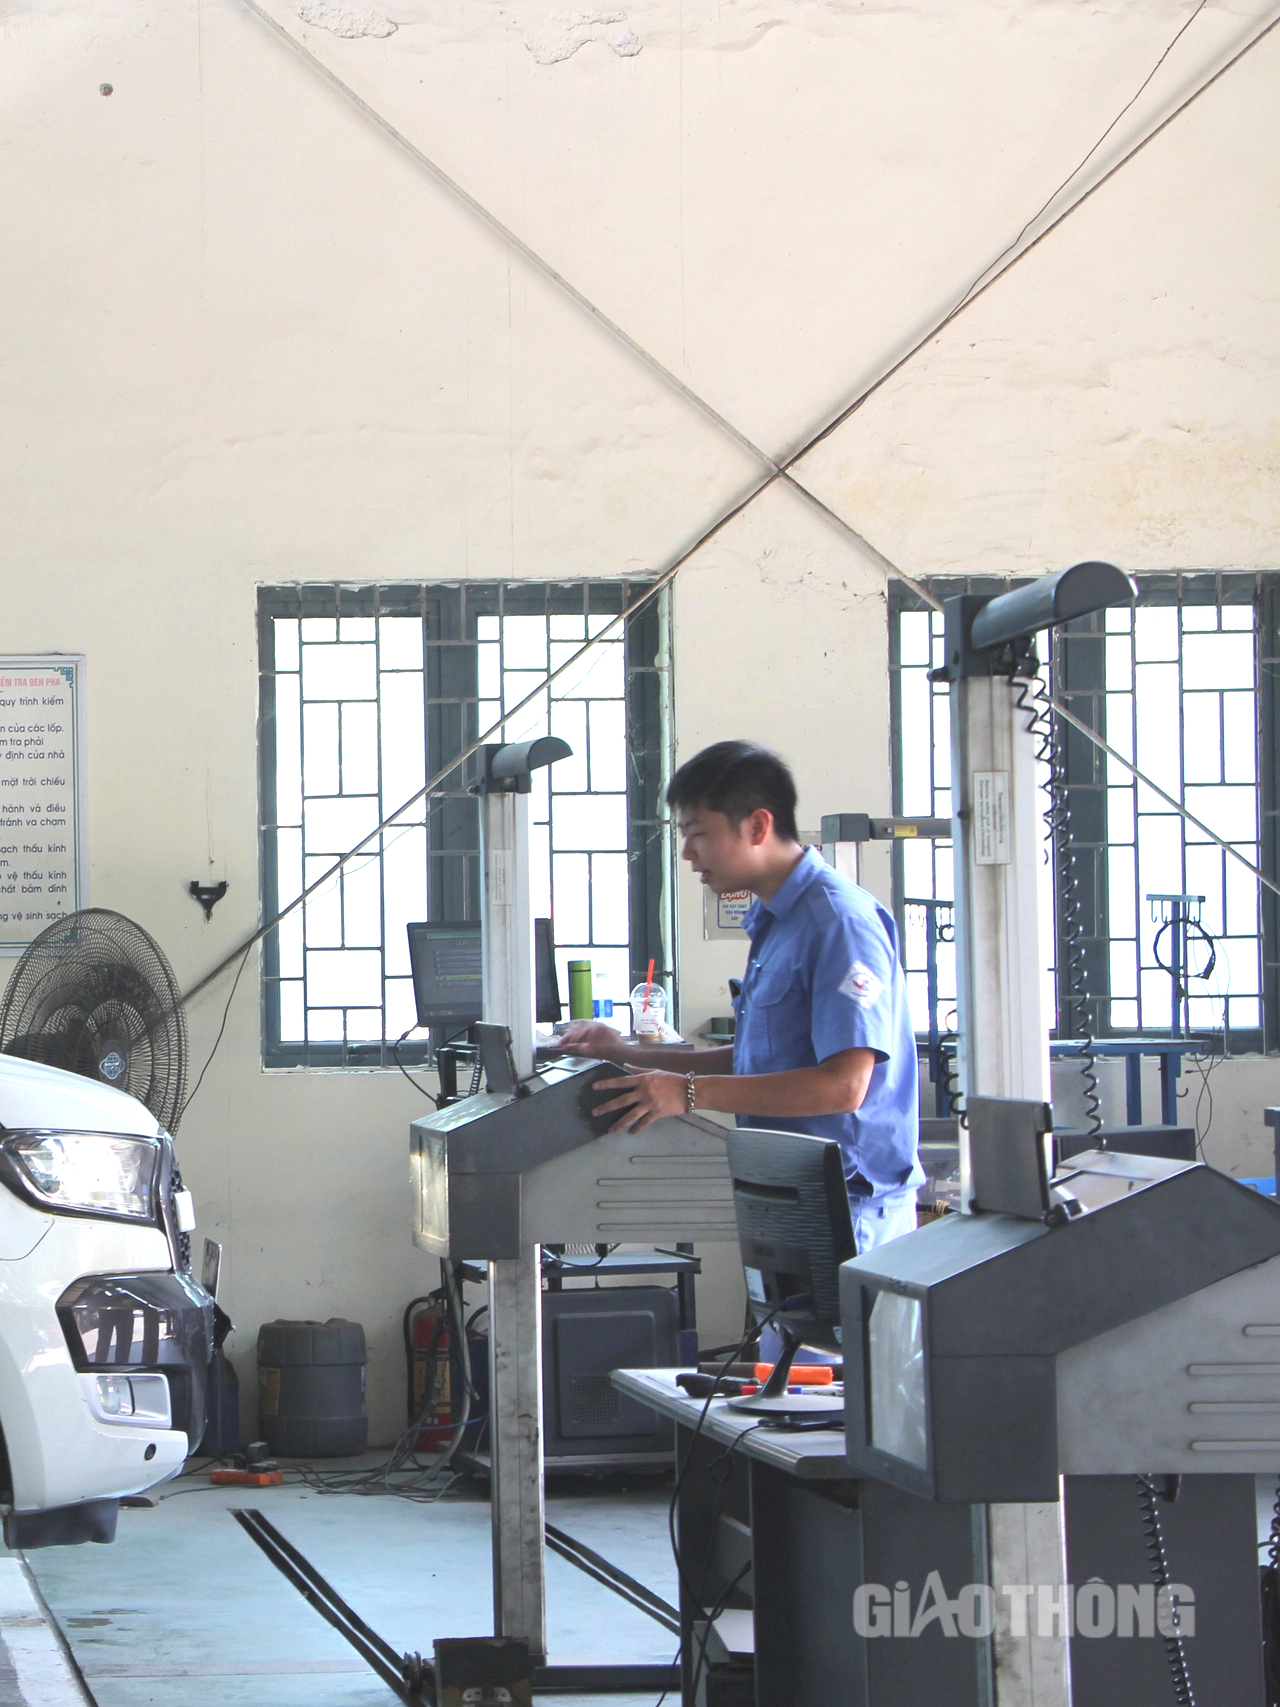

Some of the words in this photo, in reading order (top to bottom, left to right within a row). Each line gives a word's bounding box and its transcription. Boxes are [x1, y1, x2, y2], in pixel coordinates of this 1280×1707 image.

[14, 678, 27, 686] TRA
[46, 678, 60, 686] PHA
[0, 699, 16, 707] quy
[42, 695, 64, 705] kiểm
[8, 723, 25, 733] của
[28, 723, 45, 732] các
[10, 738, 22, 746] tra
[24, 736, 44, 747] phải
[5, 751, 24, 761] định
[27, 750, 44, 759] của
[2, 804, 24, 813] hành
[30, 804, 41, 813] và
[0, 818, 23, 826] tránh
[40, 818, 66, 828] chạm
[48, 844, 66, 852] kính
[7, 872, 18, 881] vệ
[48, 870, 67, 879] kính
[21, 884, 42, 893] bám
[12, 912, 22, 922] vệ
[26, 912, 43, 920] sinh
